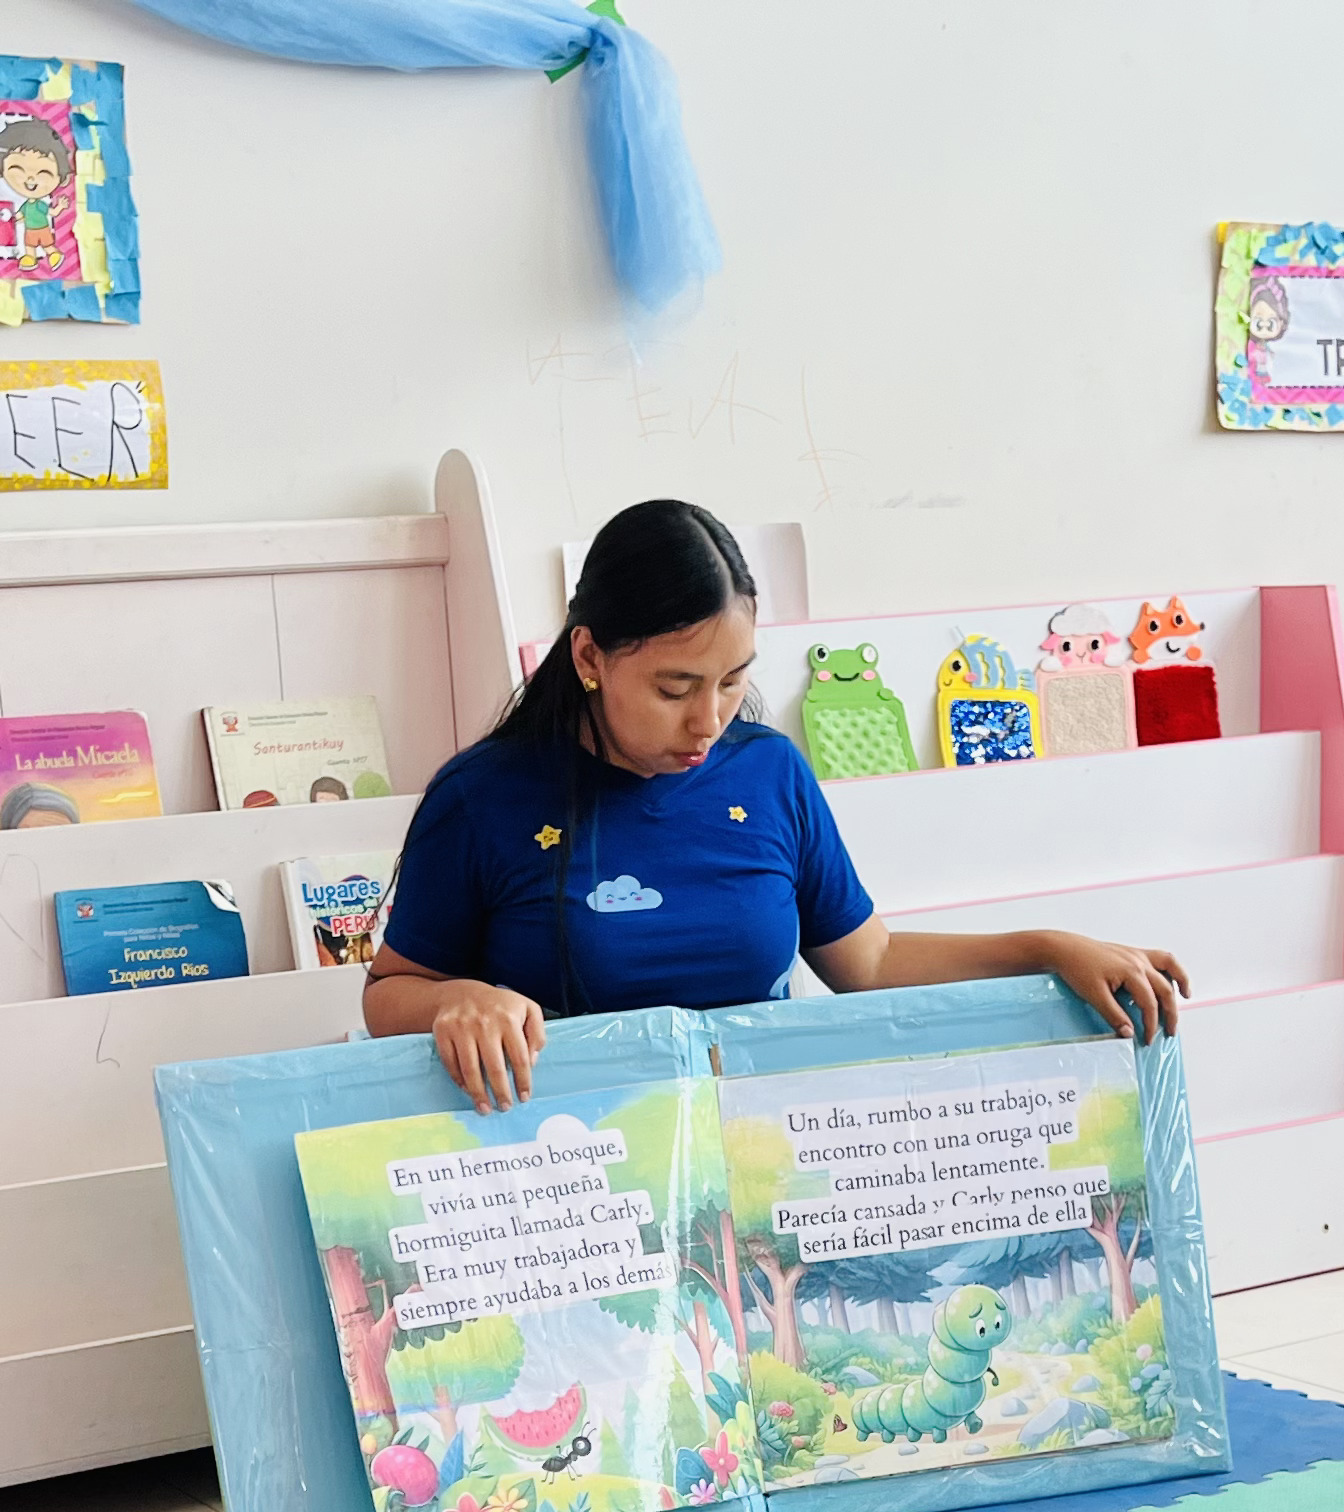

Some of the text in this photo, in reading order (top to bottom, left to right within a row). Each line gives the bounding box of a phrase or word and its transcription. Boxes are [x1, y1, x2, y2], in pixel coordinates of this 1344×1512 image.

[14, 752, 32, 771] La
[75, 742, 140, 767] Micaela
[253, 737, 345, 756] Santurantikuy
[301, 881, 381, 908] Lugares
[124, 946, 188, 963] Francisco
[109, 964, 175, 989] Izquierdo
[787, 1089, 1077, 1134] Un día, rumbo a su trabajo, se
[798, 1119, 1074, 1165] encontro con una oruga que
[393, 1140, 624, 1188] En un hermoso bosque,
[834, 1152, 1046, 1192] caminaba lentamente.
[428, 1175, 604, 1216] vivía una pequeña
[777, 1200, 848, 1230] Parecía
[853, 1194, 927, 1222] cansada
[394, 1197, 650, 1255] hormiguita llamada Carly.
[803, 1200, 1088, 1254] sería fácil pasar encima de ella
[423, 1236, 637, 1285] Era muy trabajadora y
[400, 1260, 674, 1323] siempre ayudaba a los demás
